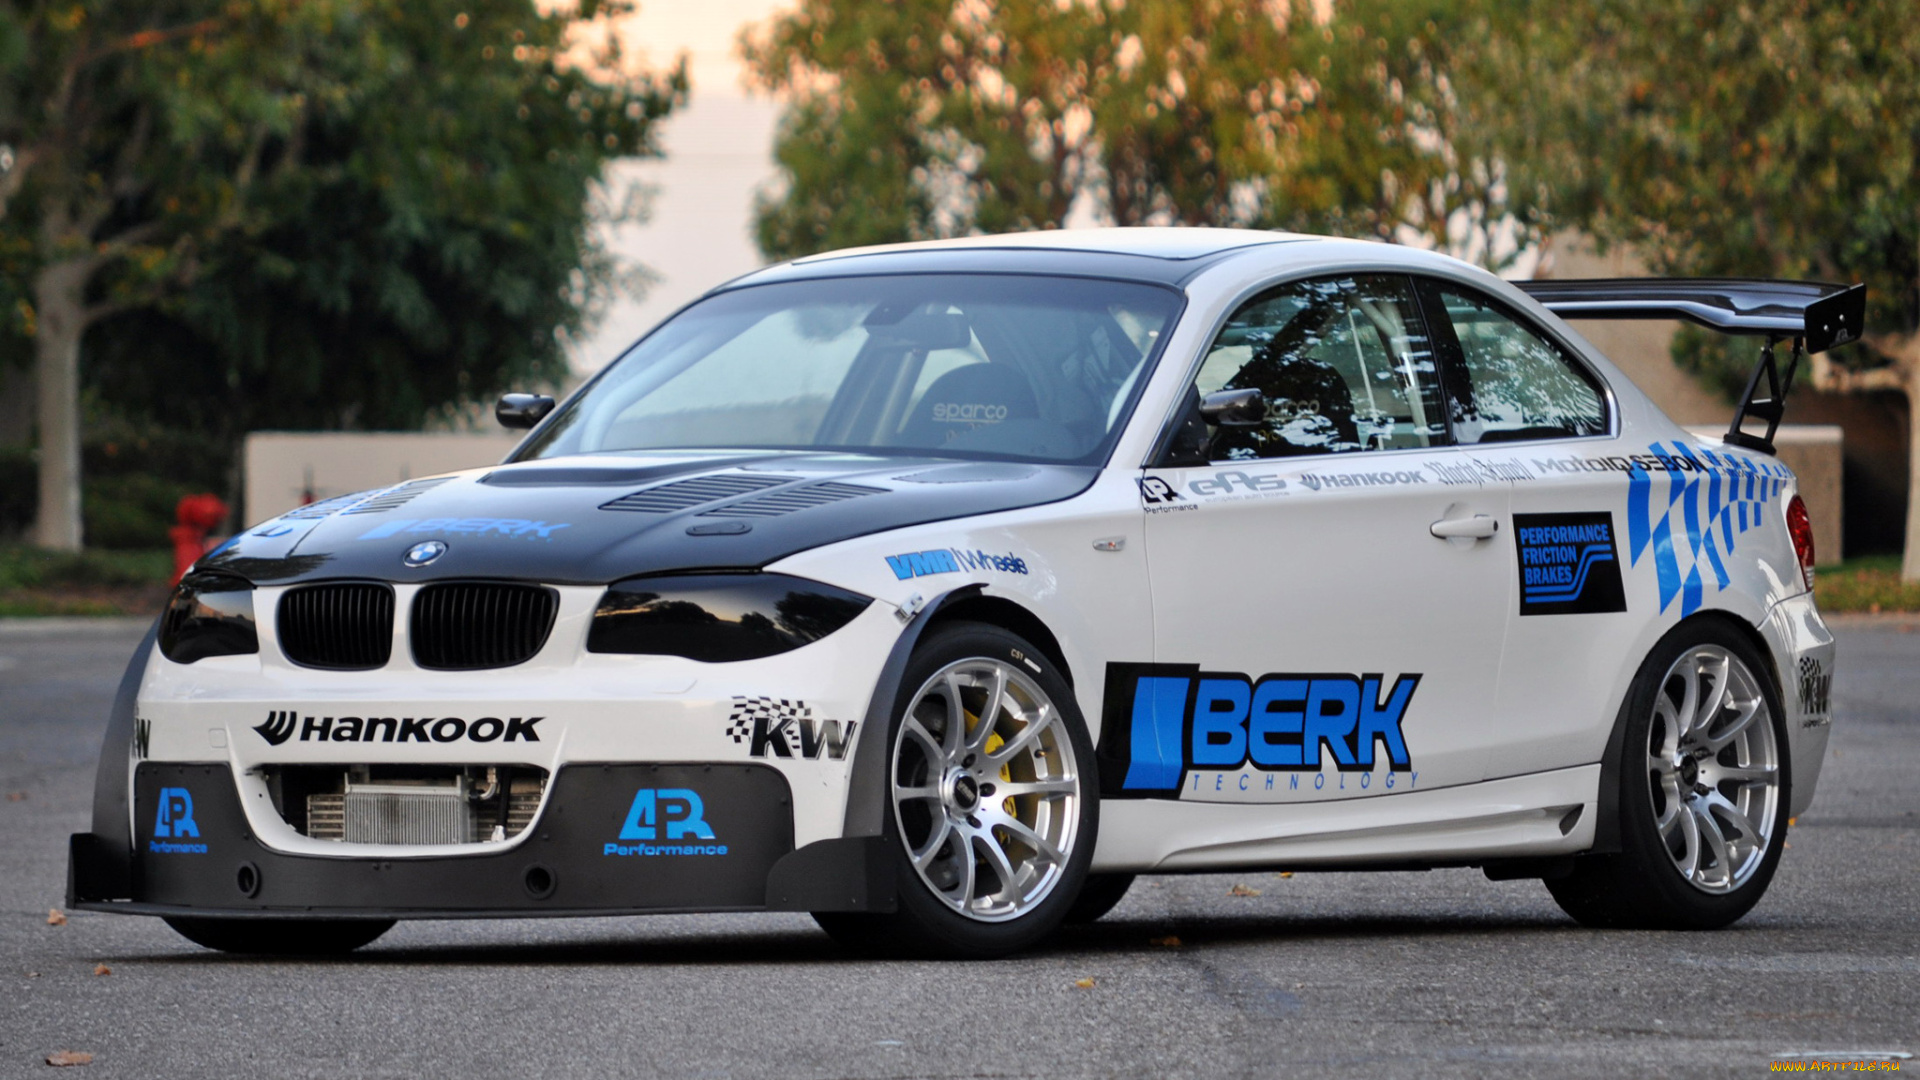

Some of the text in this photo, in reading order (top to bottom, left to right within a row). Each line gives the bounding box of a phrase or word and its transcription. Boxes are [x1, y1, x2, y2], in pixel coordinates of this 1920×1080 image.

[933, 403, 1008, 422] sparco
[1531, 455, 1638, 480] MotoIQ
[1630, 454, 1709, 473] SEBON
[1145, 503, 1199, 515] Performance
[403, 517, 573, 538] BERK
[1519, 523, 1610, 545] PERFORMANCE
[885, 548, 1029, 581] VMR Wheels
[1521, 545, 1578, 566] FRICTION
[1524, 565, 1574, 586] BRAKES
[1190, 673, 1422, 771] BERK
[749, 716, 858, 761] KW
[1193, 771, 1420, 791] TECHNOLOGY
[154, 787, 201, 838] APR
[618, 788, 716, 840] APR
[149, 839, 208, 854] Performance
[603, 842, 729, 857] Performance
